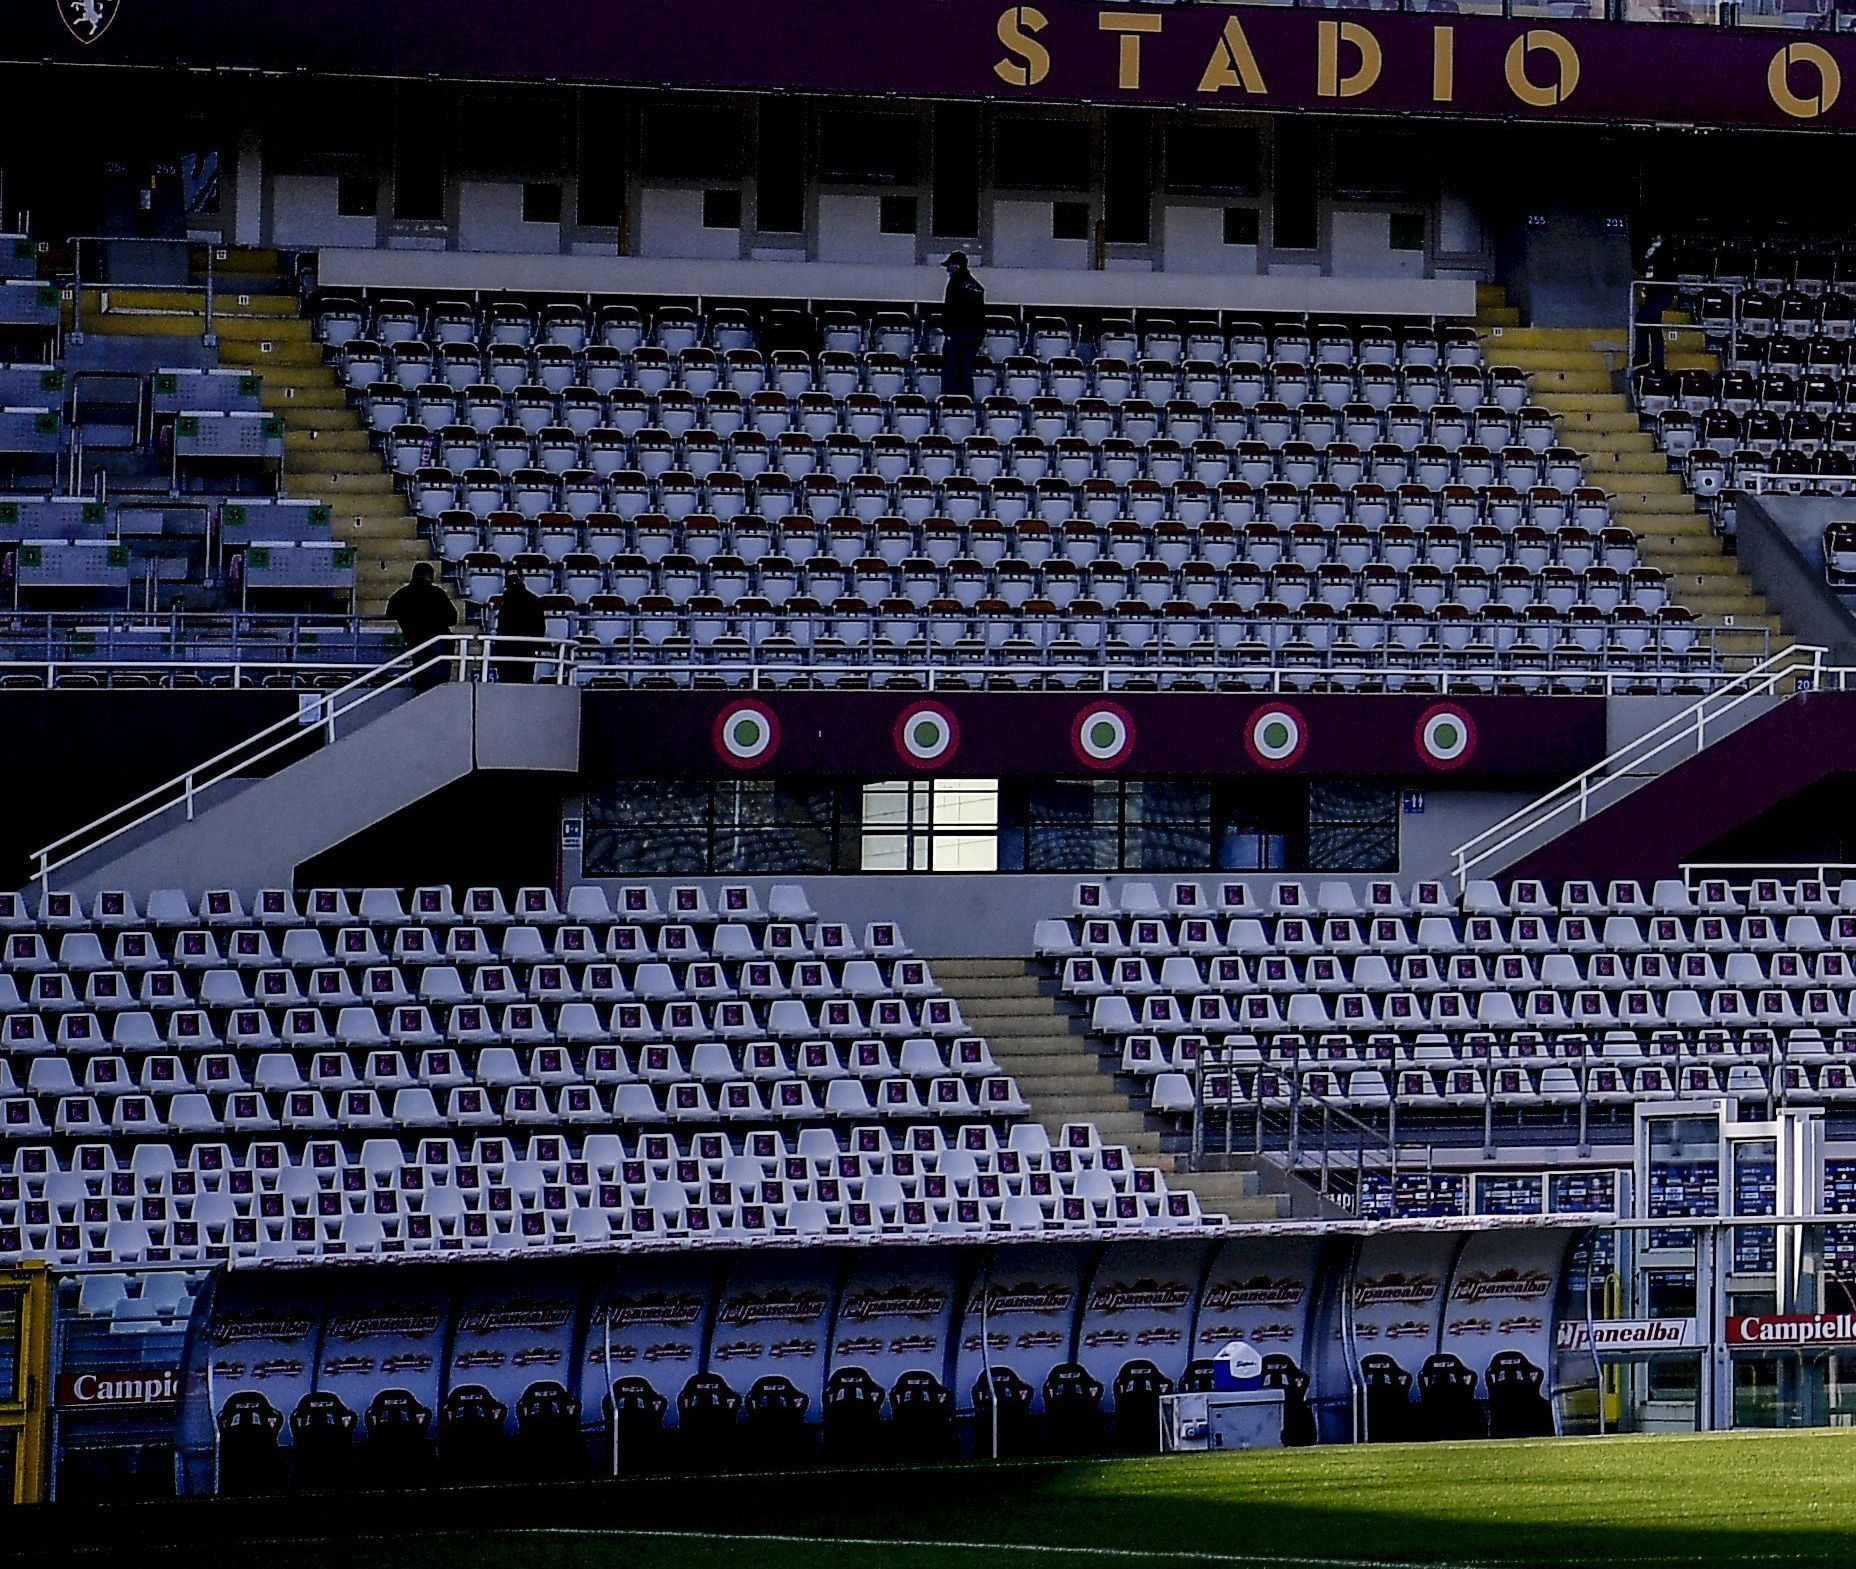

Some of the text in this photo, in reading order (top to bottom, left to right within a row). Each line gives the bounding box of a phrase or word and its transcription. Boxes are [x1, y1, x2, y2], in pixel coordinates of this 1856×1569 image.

[993, 5, 1583, 108] STADIO
[1477, 1281, 1547, 1295] panealba
[1577, 1323, 1680, 1344] panealba
